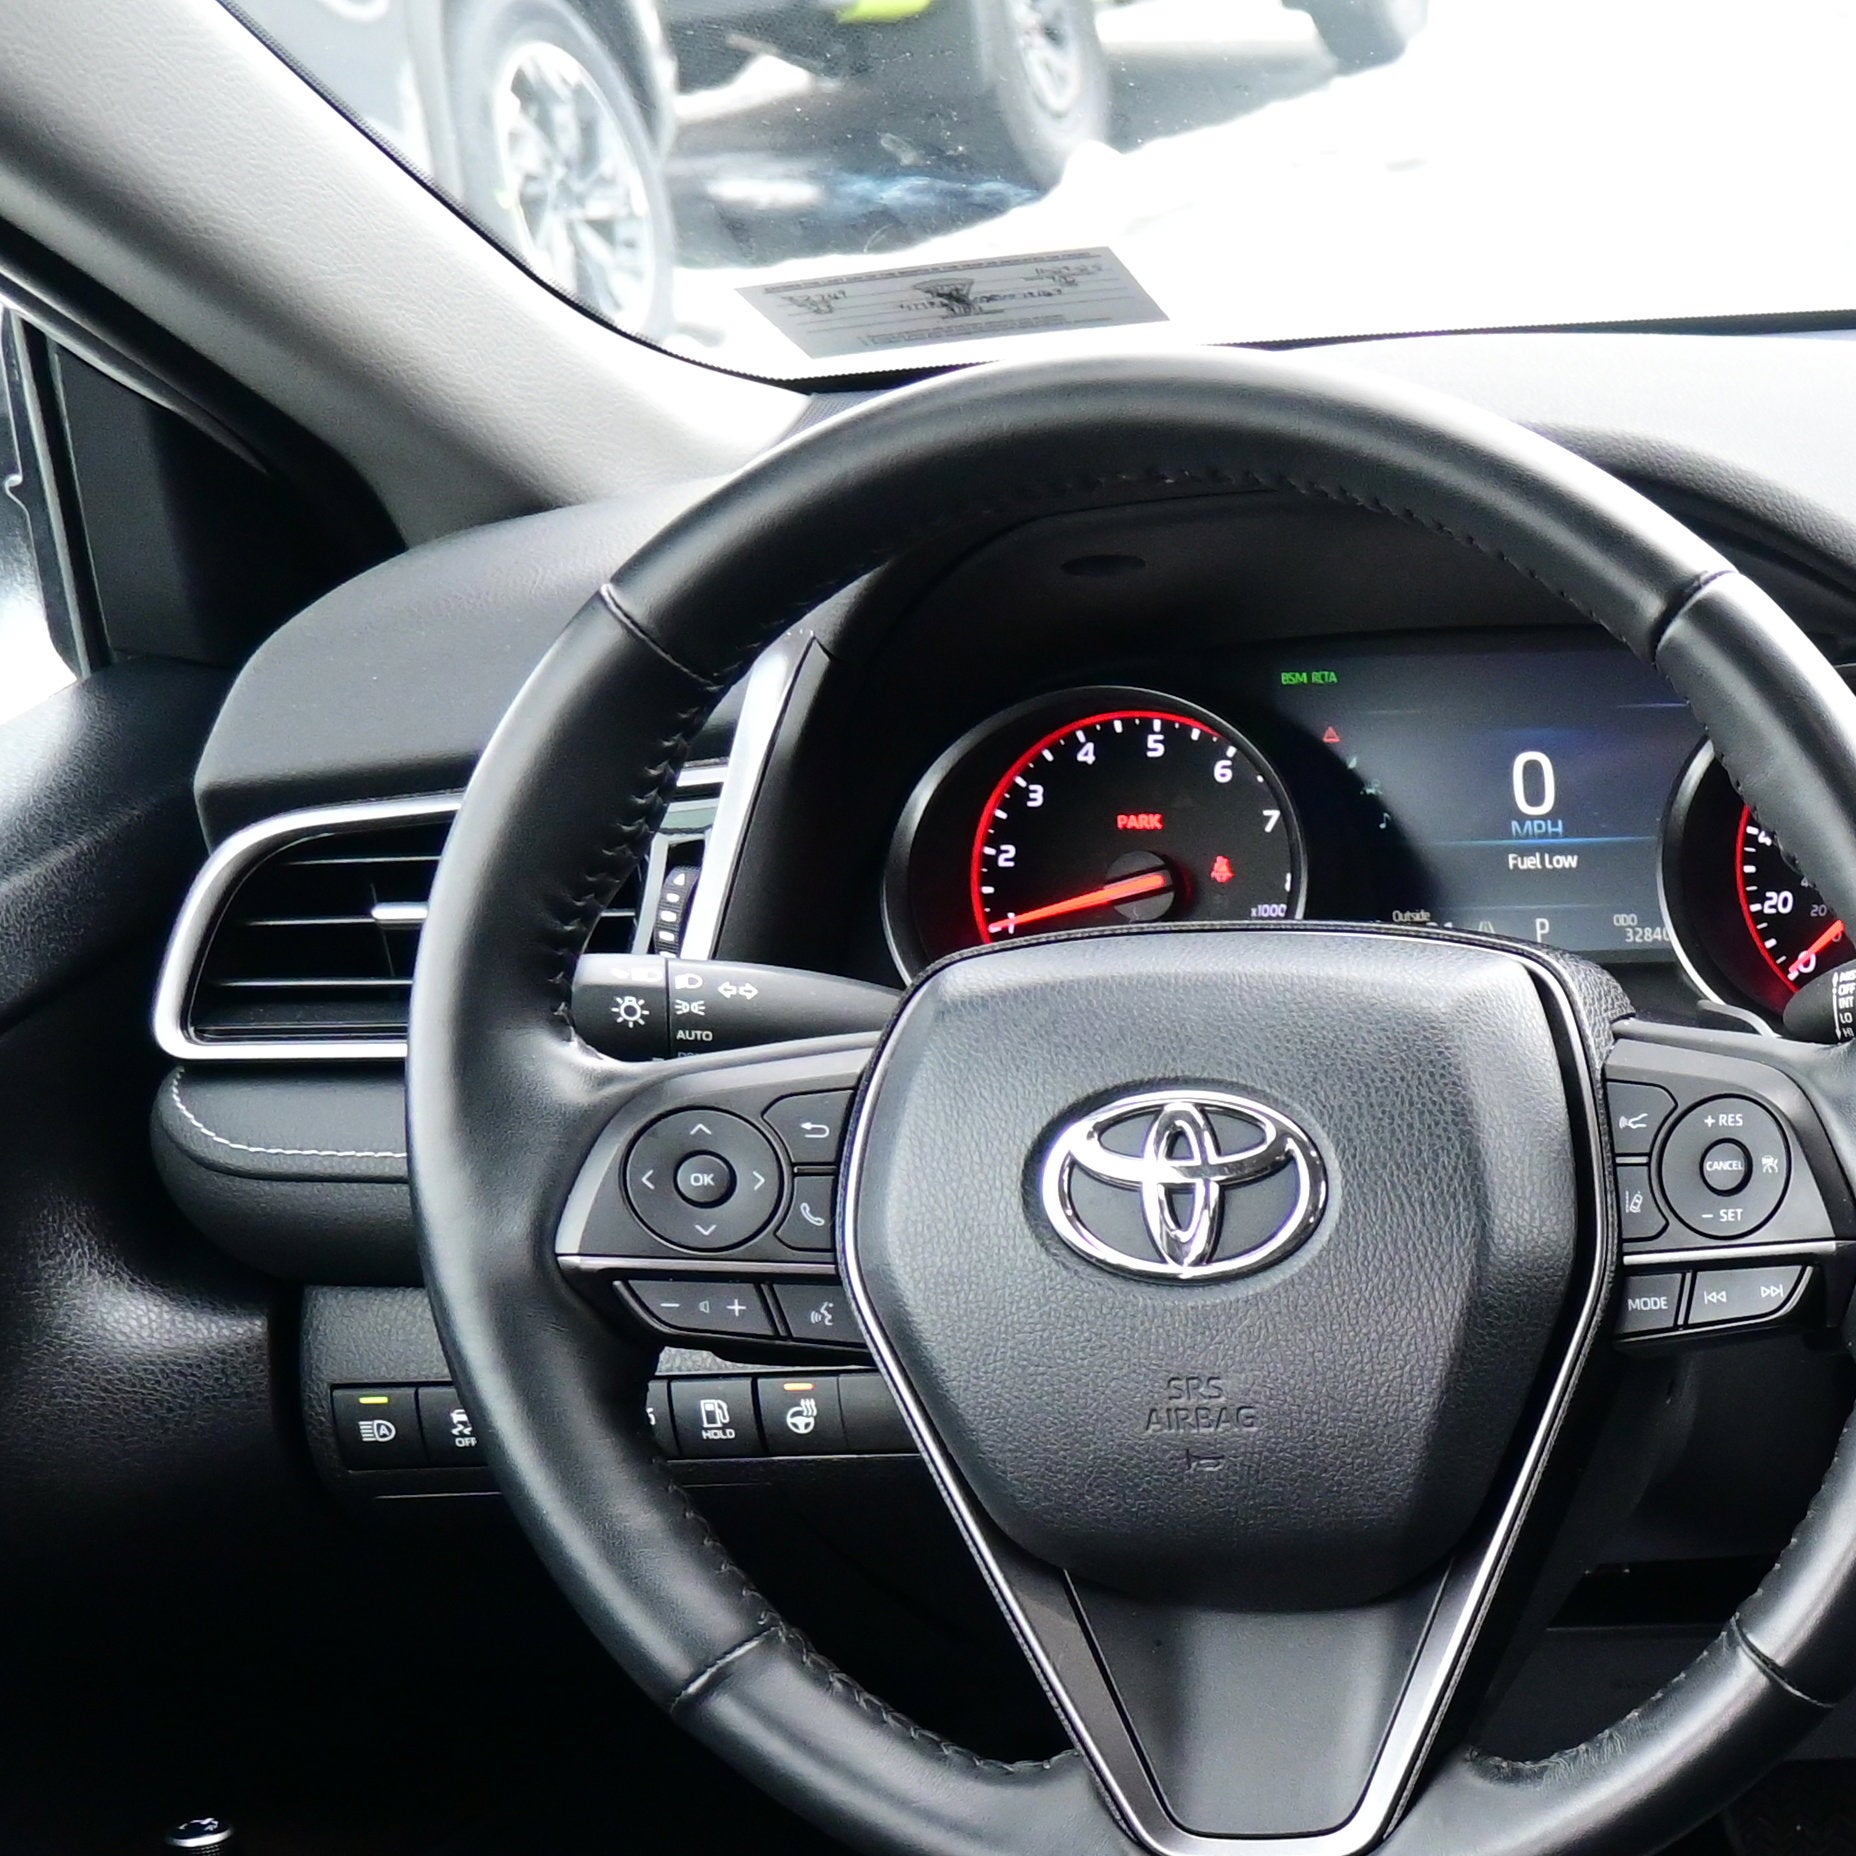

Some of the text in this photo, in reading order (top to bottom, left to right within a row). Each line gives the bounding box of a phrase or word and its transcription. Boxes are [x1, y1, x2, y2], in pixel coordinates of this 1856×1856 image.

[1281, 672, 1308, 685] BSM
[1077, 741, 1096, 765] 4
[1146, 733, 1165, 758] 5
[1213, 761, 1233, 784] 6
[1512, 750, 1556, 816] 0
[1027, 785, 1044, 808] 3
[1116, 813, 1162, 830] PARK
[1263, 809, 1281, 833] 7
[1511, 820, 1563, 838] MPH
[997, 845, 1016, 868] 2
[1508, 853, 1578, 870] Fuel Low
[1763, 891, 1793, 914] 20
[1393, 910, 1431, 922] Outside
[1613, 914, 1638, 926] ODO
[1535, 918, 1550, 943] P
[1838, 982, 1856, 995] OFF
[1838, 996, 1854, 1009] INT
[1840, 1012, 1853, 1024] LO
[676, 1030, 713, 1041] AUTO
[1718, 1113, 1743, 1127] RES
[1706, 1159, 1744, 1172] CANCEL
[690, 1172, 714, 1187] OK
[1718, 1208, 1743, 1222] SET
[1627, 1295, 1669, 1312] MODE
[1166, 1376, 1222, 1401] SRS
[1144, 1406, 1257, 1432] AIRBAG
[455, 1437, 477, 1447] OFF
[702, 1427, 735, 1440] HOLD
